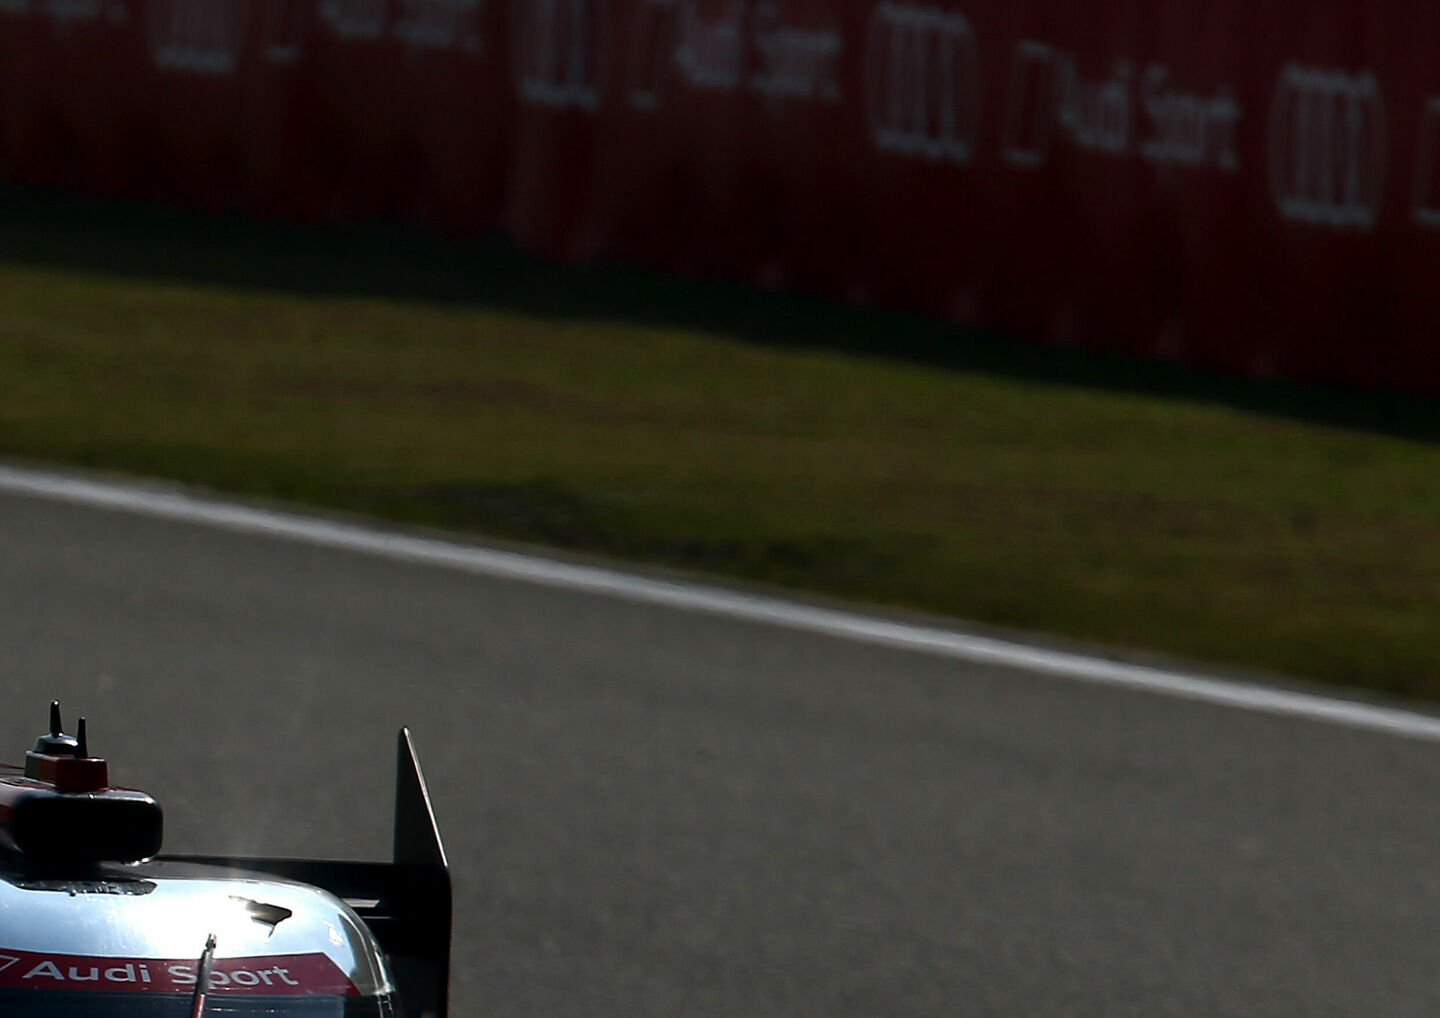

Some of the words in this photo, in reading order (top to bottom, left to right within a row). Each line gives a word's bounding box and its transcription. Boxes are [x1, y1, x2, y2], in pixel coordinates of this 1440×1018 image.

[1056, 50, 1134, 154] Audi
[1141, 60, 1246, 182] Sport
[22, 960, 153, 983] Audi
[166, 963, 300, 989] Sport
